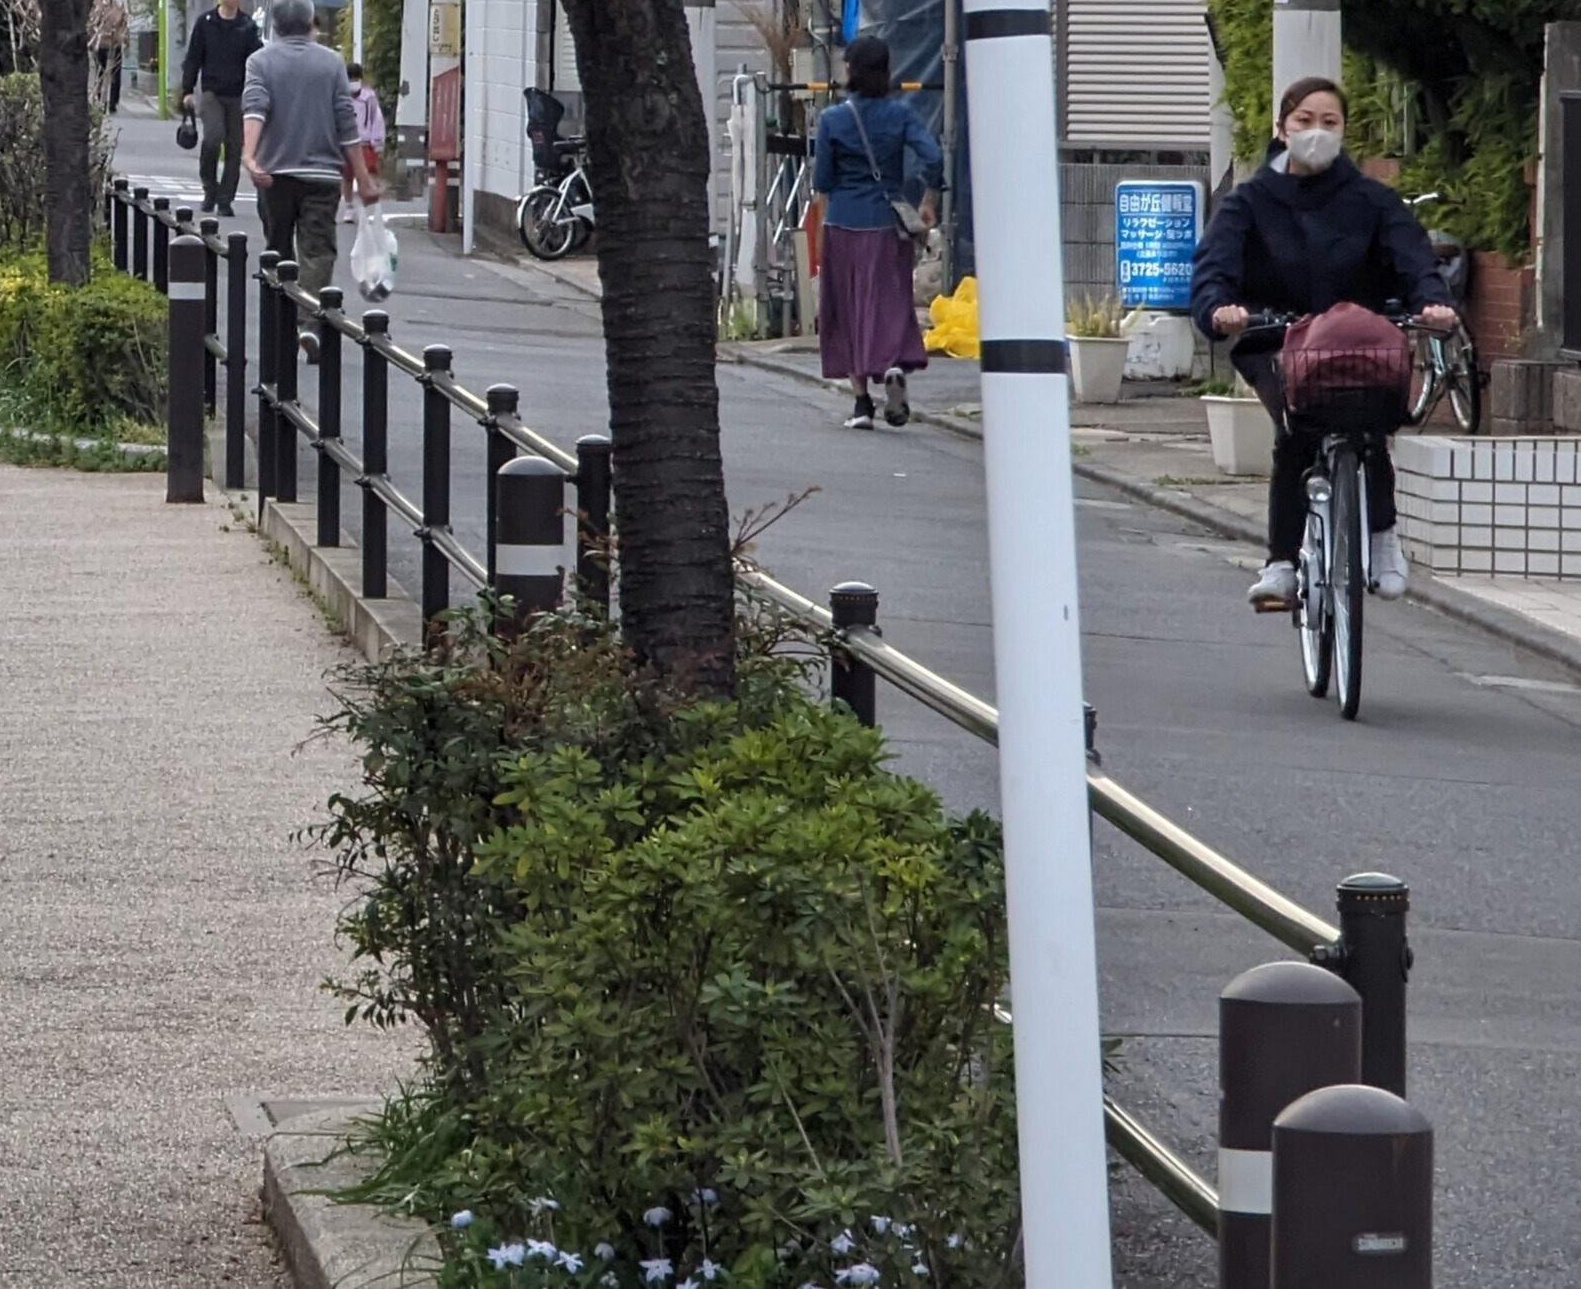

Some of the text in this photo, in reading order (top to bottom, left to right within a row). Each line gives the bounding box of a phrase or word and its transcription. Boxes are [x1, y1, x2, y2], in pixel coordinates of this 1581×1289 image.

[1119, 193, 1193, 213] 自由が丘
[1131, 262, 1194, 277] 3725-5620
